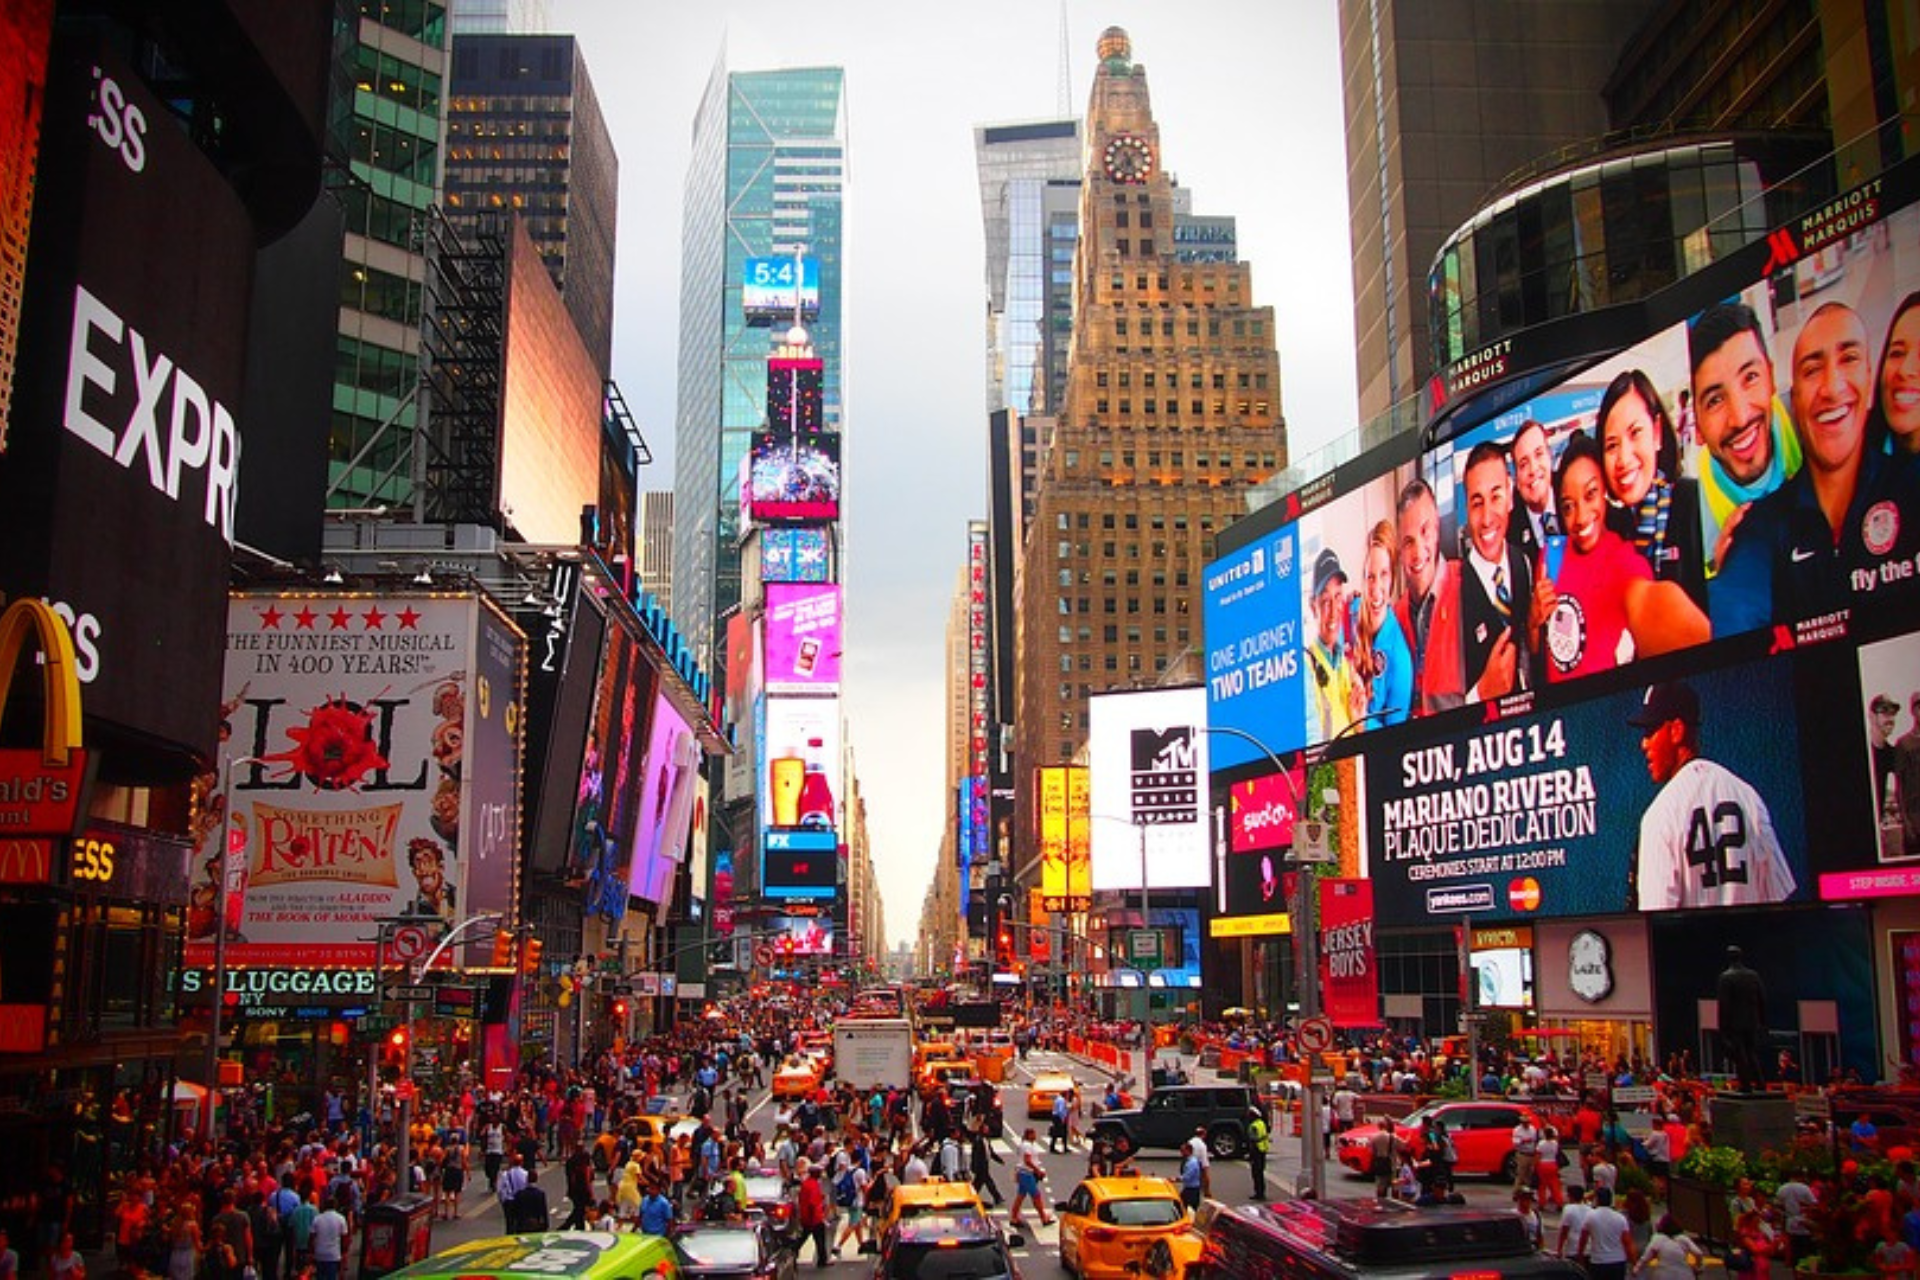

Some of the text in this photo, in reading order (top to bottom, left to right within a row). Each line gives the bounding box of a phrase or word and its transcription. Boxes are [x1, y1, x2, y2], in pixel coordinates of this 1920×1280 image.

[1801, 179, 1882, 231] MARRIOTT
[1803, 203, 1875, 250] MARQUIS
[1448, 338, 1513, 376] MARRIOTT
[1450, 358, 1505, 392] MARQUIS
[1208, 561, 1250, 592] UNITED
[1850, 567, 1878, 592] fly
[1879, 559, 1914, 584] the
[1796, 609, 1850, 632] MARRIOTT
[1797, 623, 1846, 644] MARQUIS
[228, 634, 456, 651] THE FUNNIEST MUSICAL
[1210, 620, 1296, 672] ONE JOURNEY
[255, 653, 282, 674] IN
[287, 654, 334, 675] 400
[1211, 648, 1298, 702] TWO TEAMS
[236, 698, 429, 790] LL
[1402, 719, 1566, 788] SUN, AUG 14
[1383, 765, 1597, 831] MARIANO RIVERA
[272, 810, 381, 826] SOMETHING
[1384, 800, 1598, 862] PLAQUE DEDICATION
[1685, 800, 1749, 889] 42
[1408, 847, 1566, 881] CEREMONIES START AT 12:00 PM
[248, 912, 275, 922] THE
[313, 912, 330, 922] OF
[1321, 921, 1374, 954] JERSEY
[1329, 950, 1367, 978] BOYS
[226, 970, 376, 994] LUGGAGE
